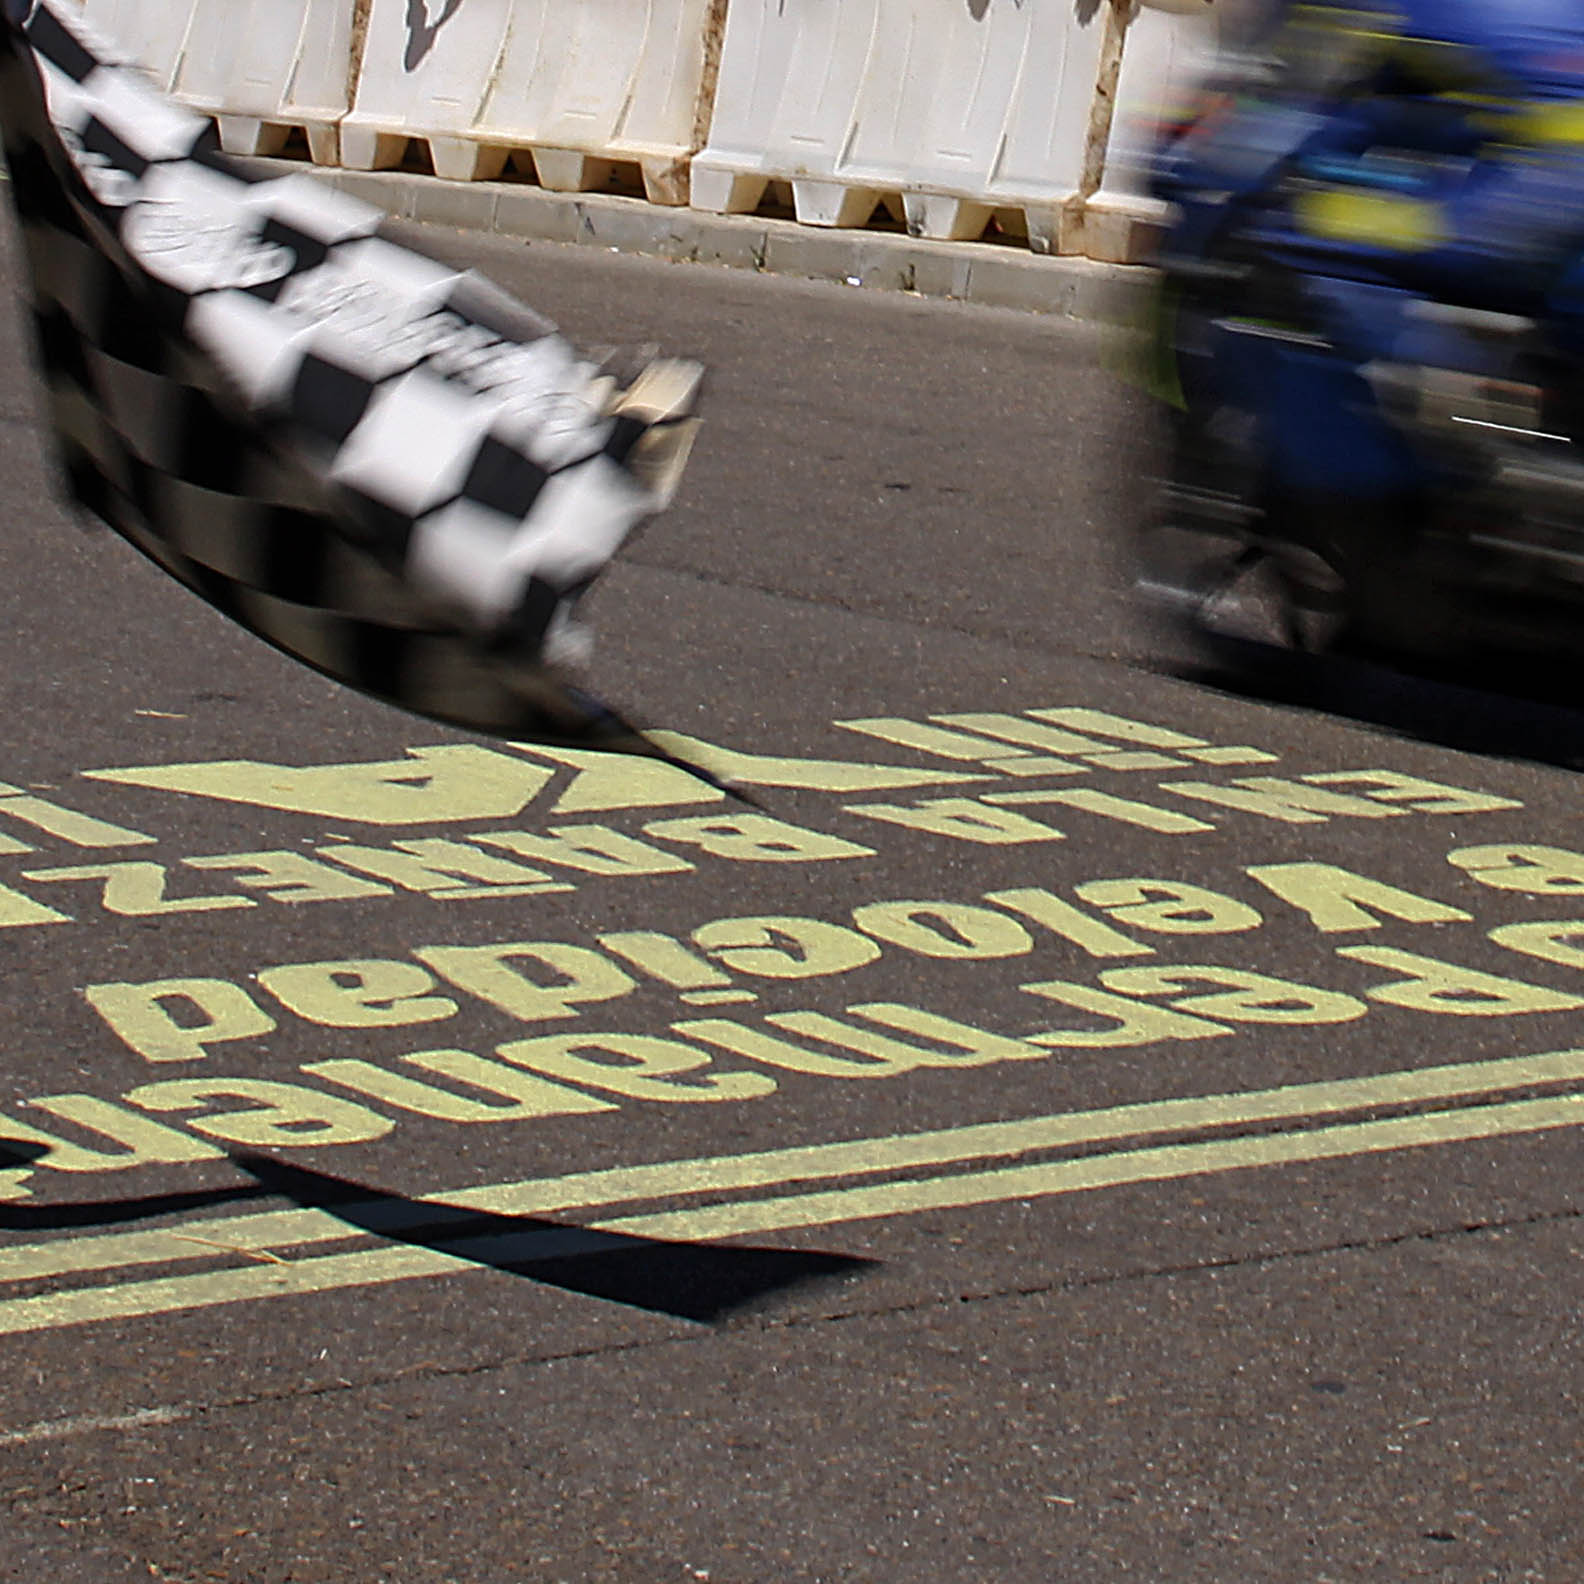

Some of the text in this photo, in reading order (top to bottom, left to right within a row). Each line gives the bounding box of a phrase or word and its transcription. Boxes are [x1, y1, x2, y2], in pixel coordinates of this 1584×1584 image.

[840, 786, 1216, 844] LA
[1158, 769, 1524, 821] EN
[86, 862, 1472, 1064] Velocidad
